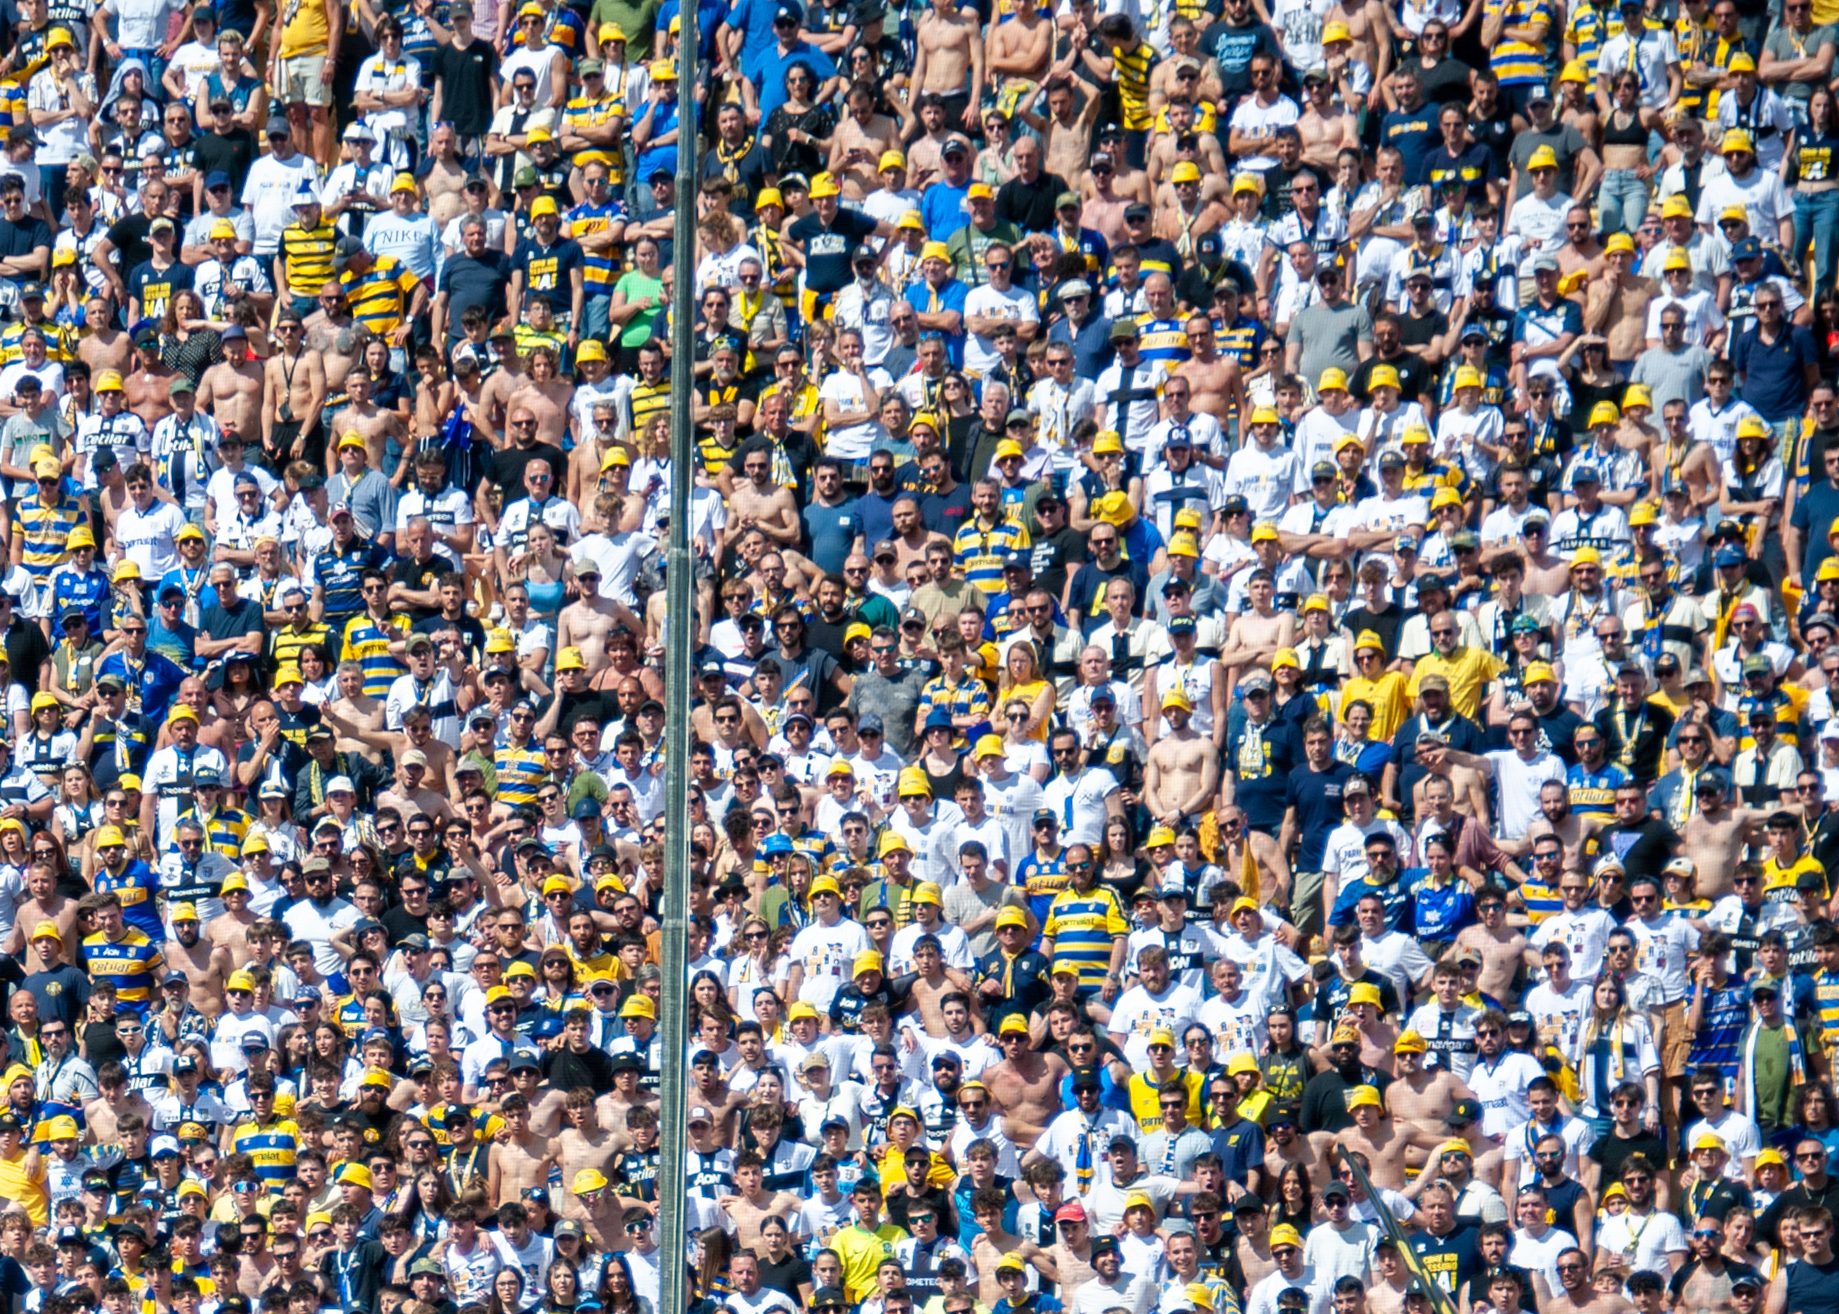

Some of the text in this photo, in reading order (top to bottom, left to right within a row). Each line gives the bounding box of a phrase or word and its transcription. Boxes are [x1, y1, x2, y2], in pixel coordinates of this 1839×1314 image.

[86, 435, 128, 444] Cetilar
[163, 786, 190, 795] PROME
[168, 887, 211, 898] PROMETEON
[1057, 917, 1095, 927] parmalat
[90, 962, 131, 972] Cetilar
[1141, 1118, 1163, 1127] parm
[694, 1174, 721, 1184] AON
